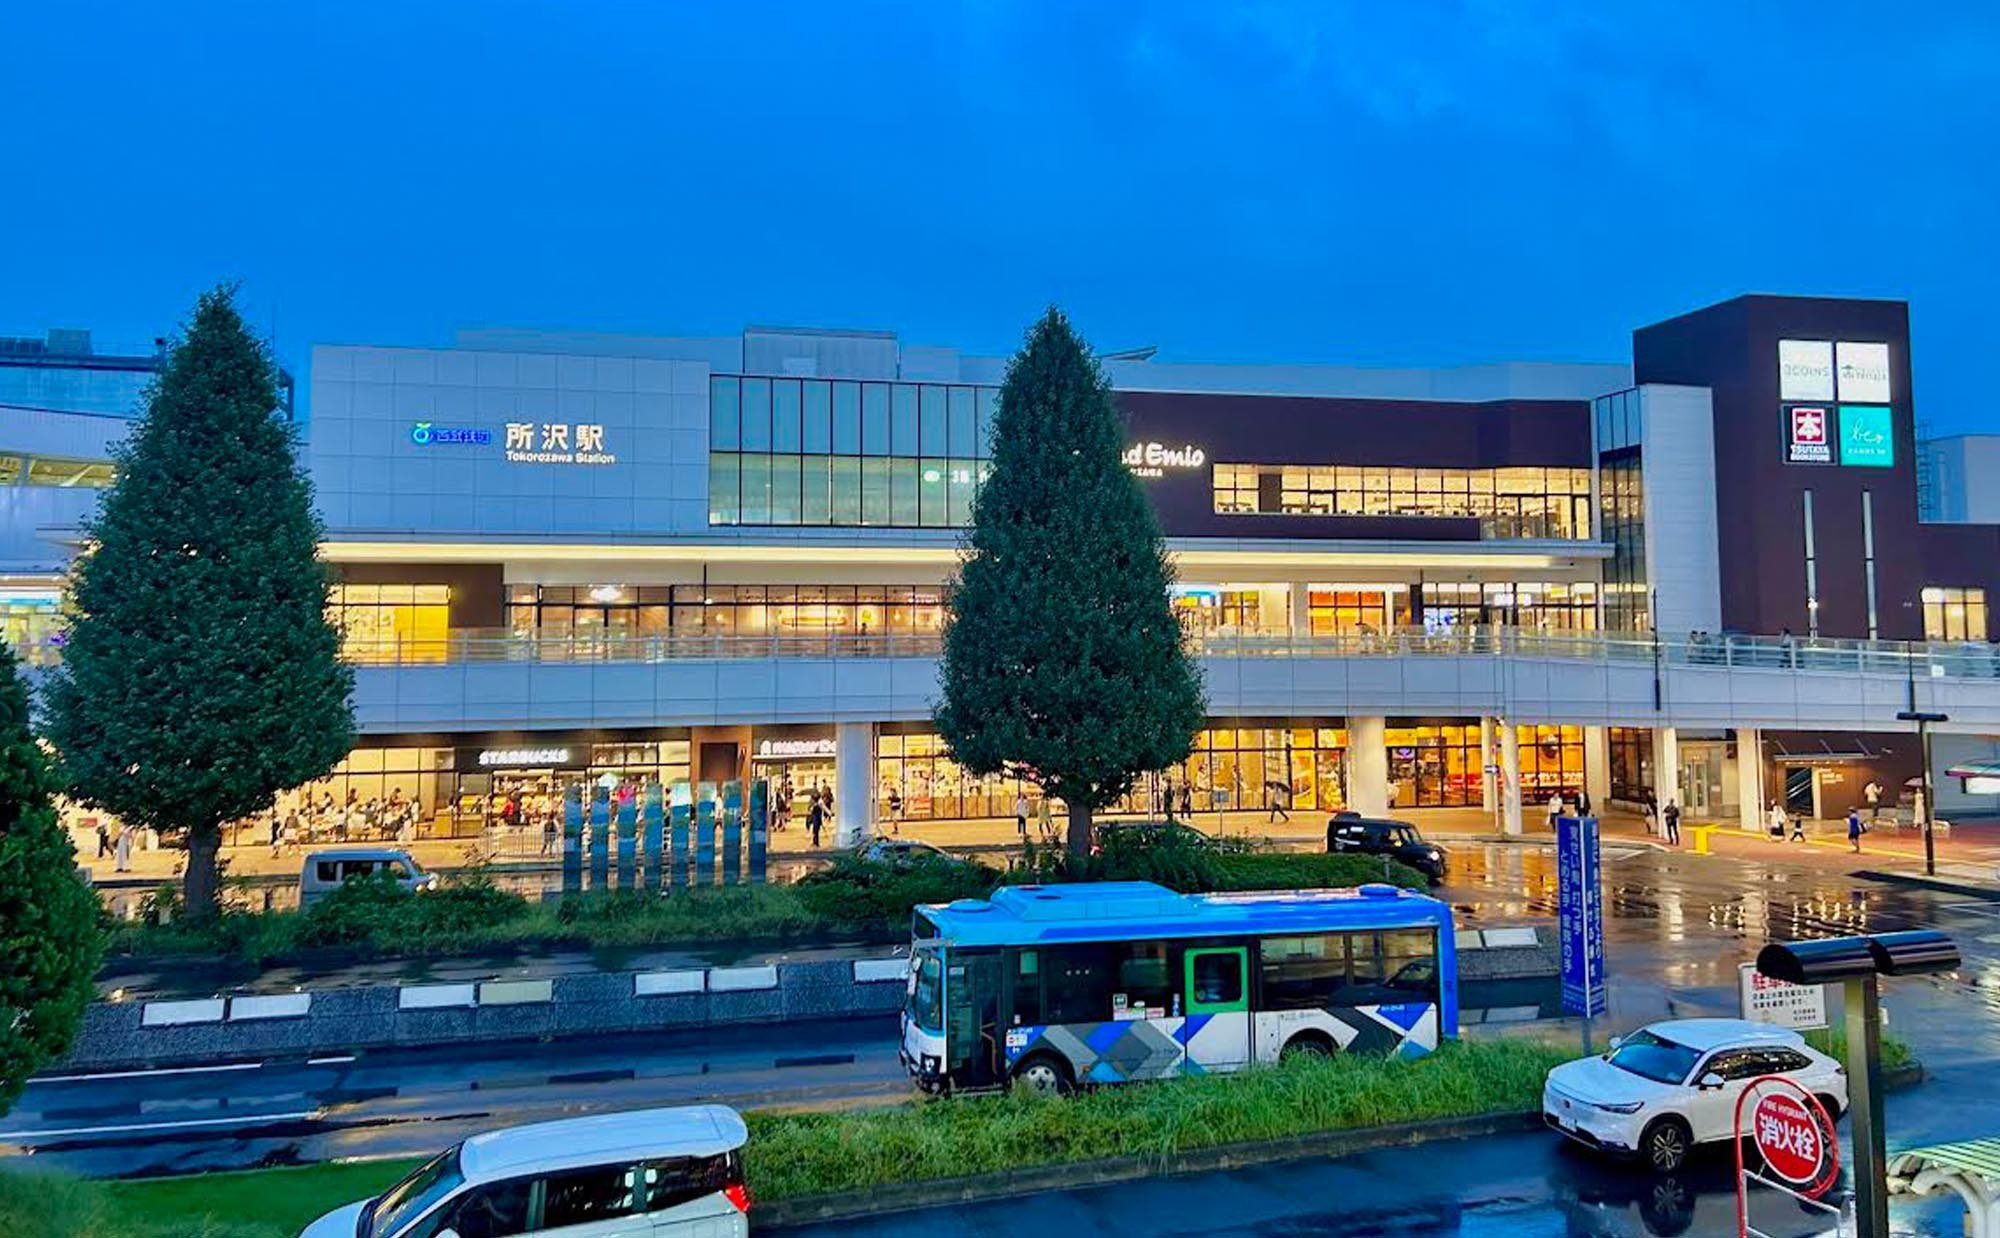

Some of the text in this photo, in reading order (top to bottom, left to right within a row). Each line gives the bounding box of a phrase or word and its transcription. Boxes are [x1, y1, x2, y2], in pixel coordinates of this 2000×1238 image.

[505, 422, 604, 451] 所沢駅
[506, 451, 616, 465] Tokorozawa Station
[1145, 442, 1205, 467] Emio
[478, 749, 570, 766] STARBUCKS
[1759, 1112, 1817, 1162] 消火栓
